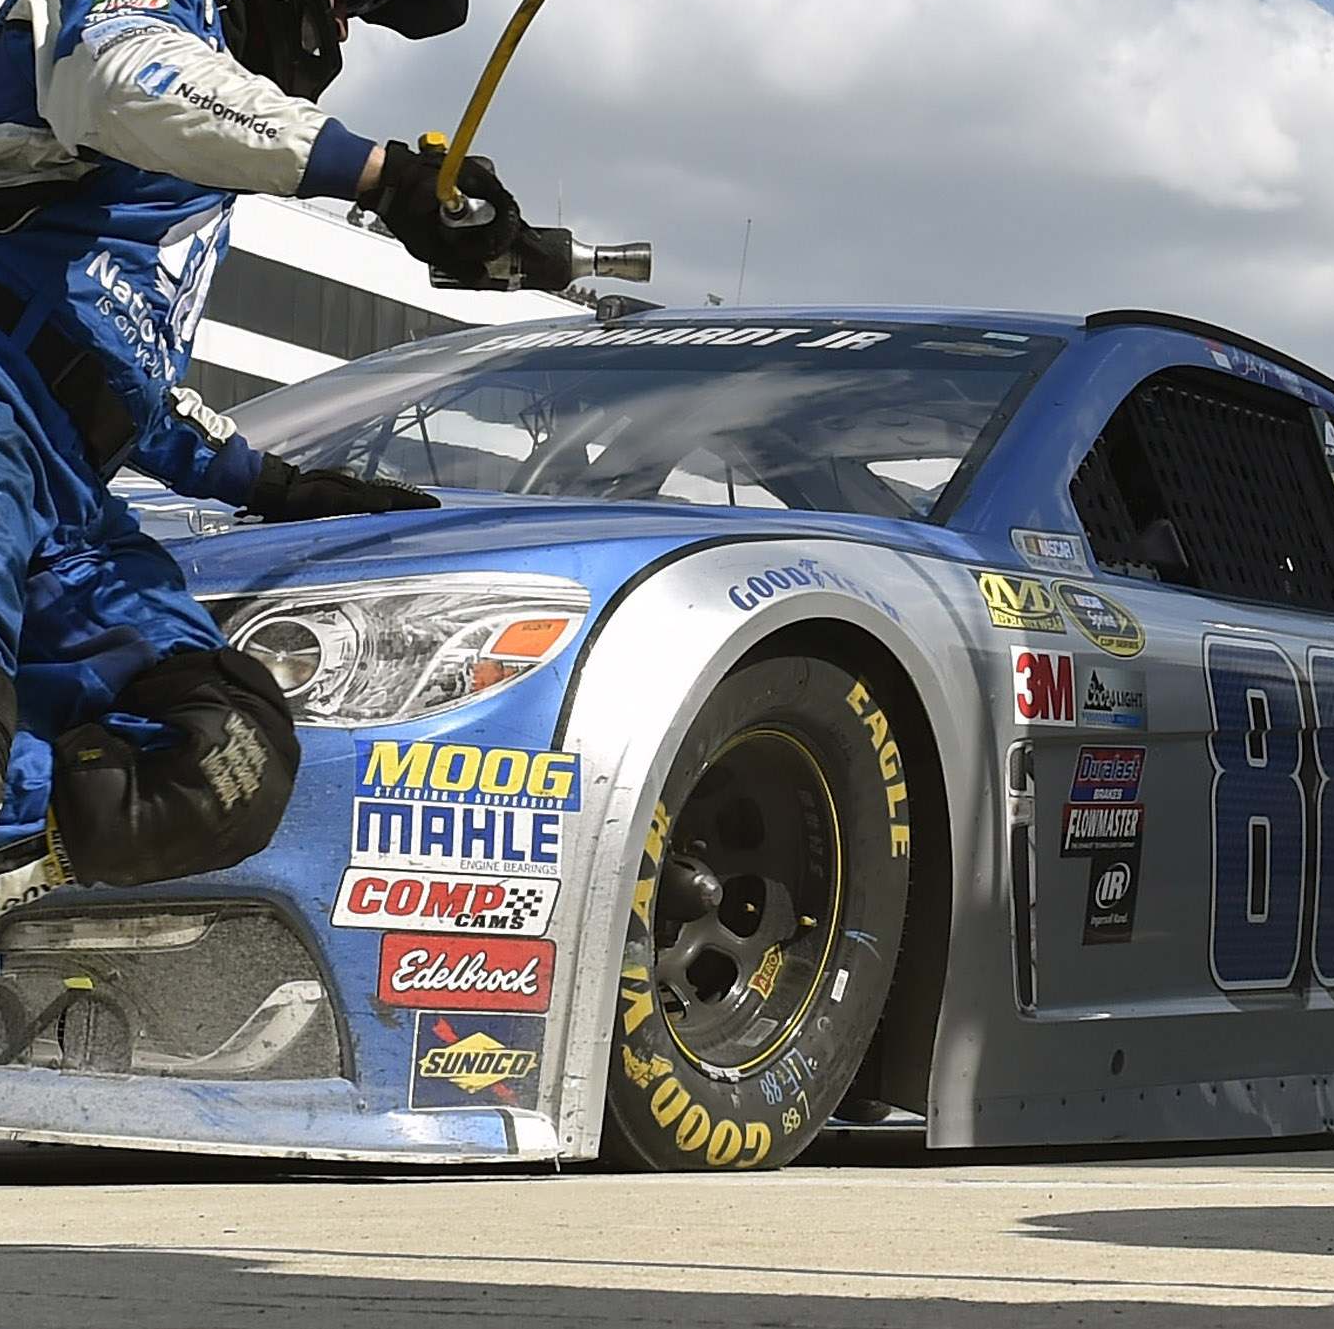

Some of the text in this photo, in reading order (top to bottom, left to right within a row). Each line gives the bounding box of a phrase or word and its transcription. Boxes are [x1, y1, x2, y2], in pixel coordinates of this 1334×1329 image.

[174, 83, 278, 139] Nationwide
[796, 330, 892, 351] JR
[1017, 652, 1074, 721] 3M
[1117, 690, 1143, 709] LIGHT
[362, 741, 576, 799] MOOG
[846, 682, 910, 859] EAGLE
[1078, 754, 1141, 782] Duralast
[356, 801, 560, 864] MAHLE
[1064, 809, 1139, 850] FLOWMASTER
[460, 860, 558, 875] ENGINE BEARINGS
[347, 877, 506, 919] COMP
[1100, 871, 1125, 901] IR
[455, 913, 525, 930] CAMS
[392, 949, 540, 995] Edelbrock
[760, 955, 778, 989] AERO
[424, 1052, 533, 1075] SUNOCO
[760, 1069, 784, 1106] 88
[781, 1106, 802, 1135] 88
